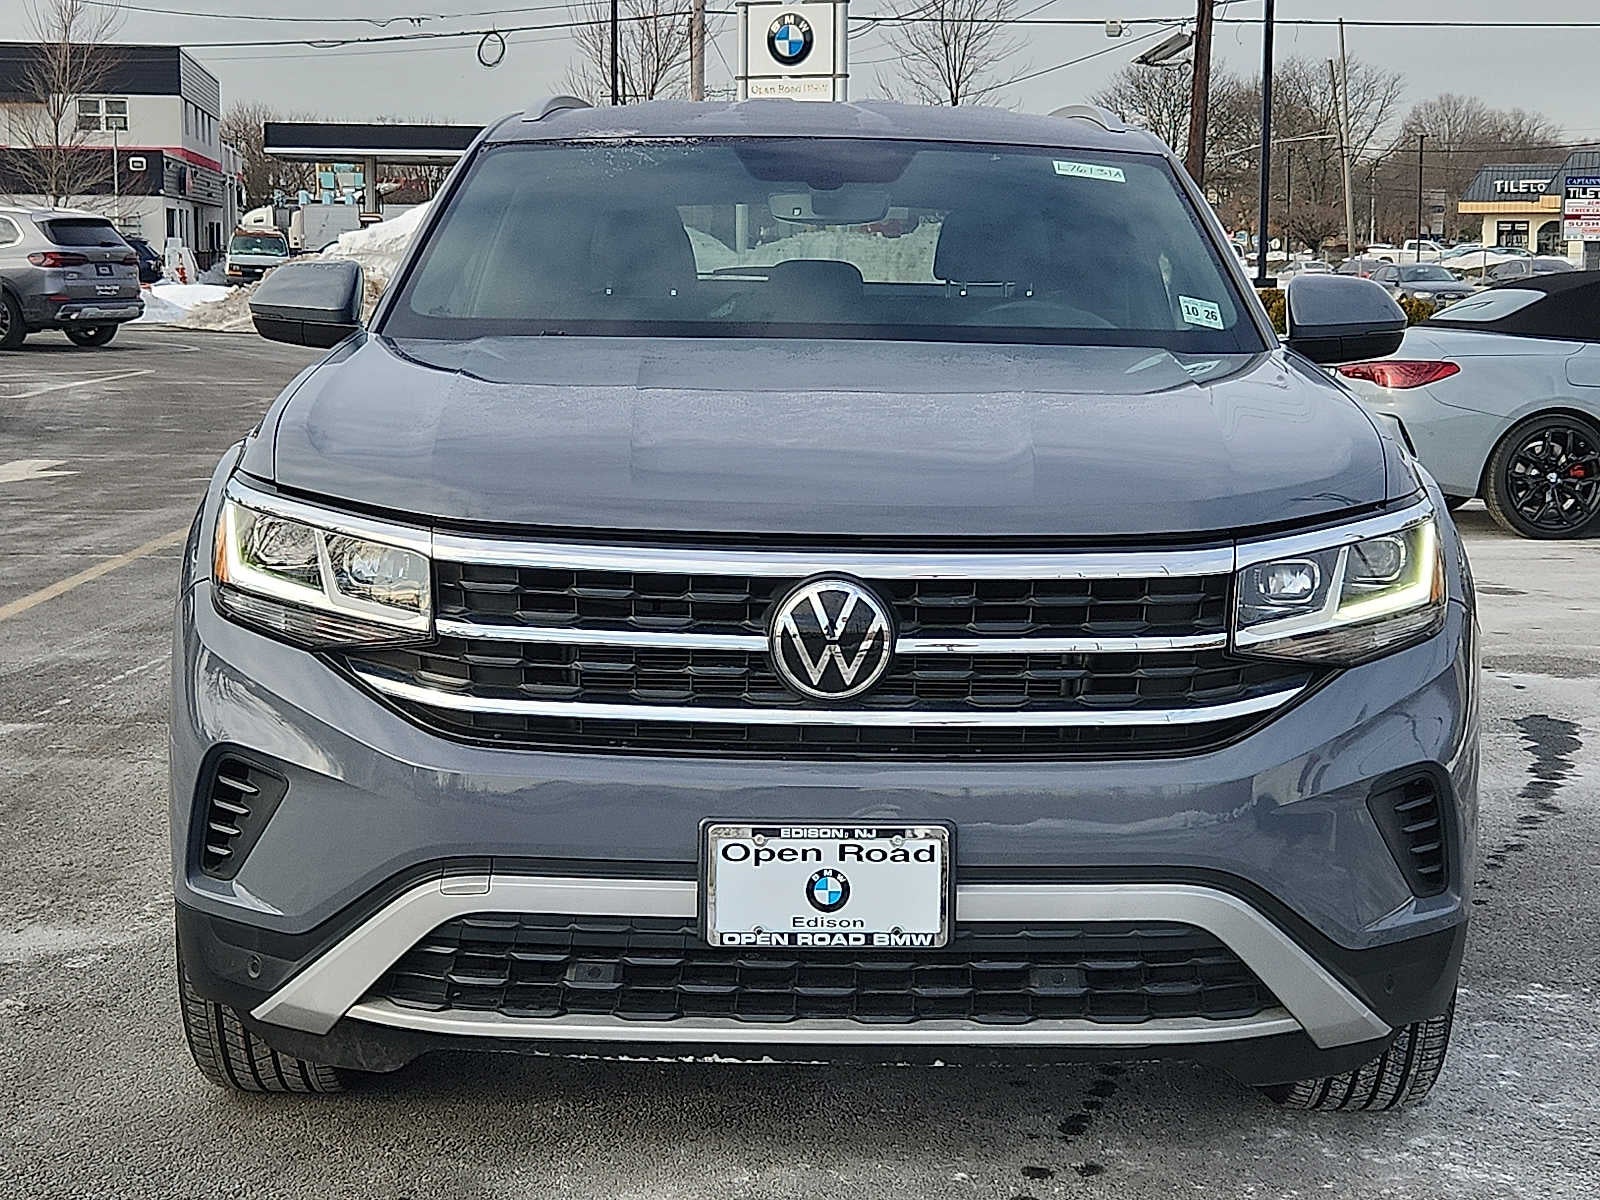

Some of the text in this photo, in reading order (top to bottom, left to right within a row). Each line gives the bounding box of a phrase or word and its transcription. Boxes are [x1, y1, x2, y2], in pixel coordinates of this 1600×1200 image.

[771, 15, 809, 33] BMW
[1185, 305, 1218, 321] 10 26
[854, 828, 877, 838] NJ
[721, 843, 935, 867] Open Road
[811, 869, 847, 883] BMW
[792, 916, 865, 928] Edison
[722, 933, 933, 946] OPEN ROAD BMW
